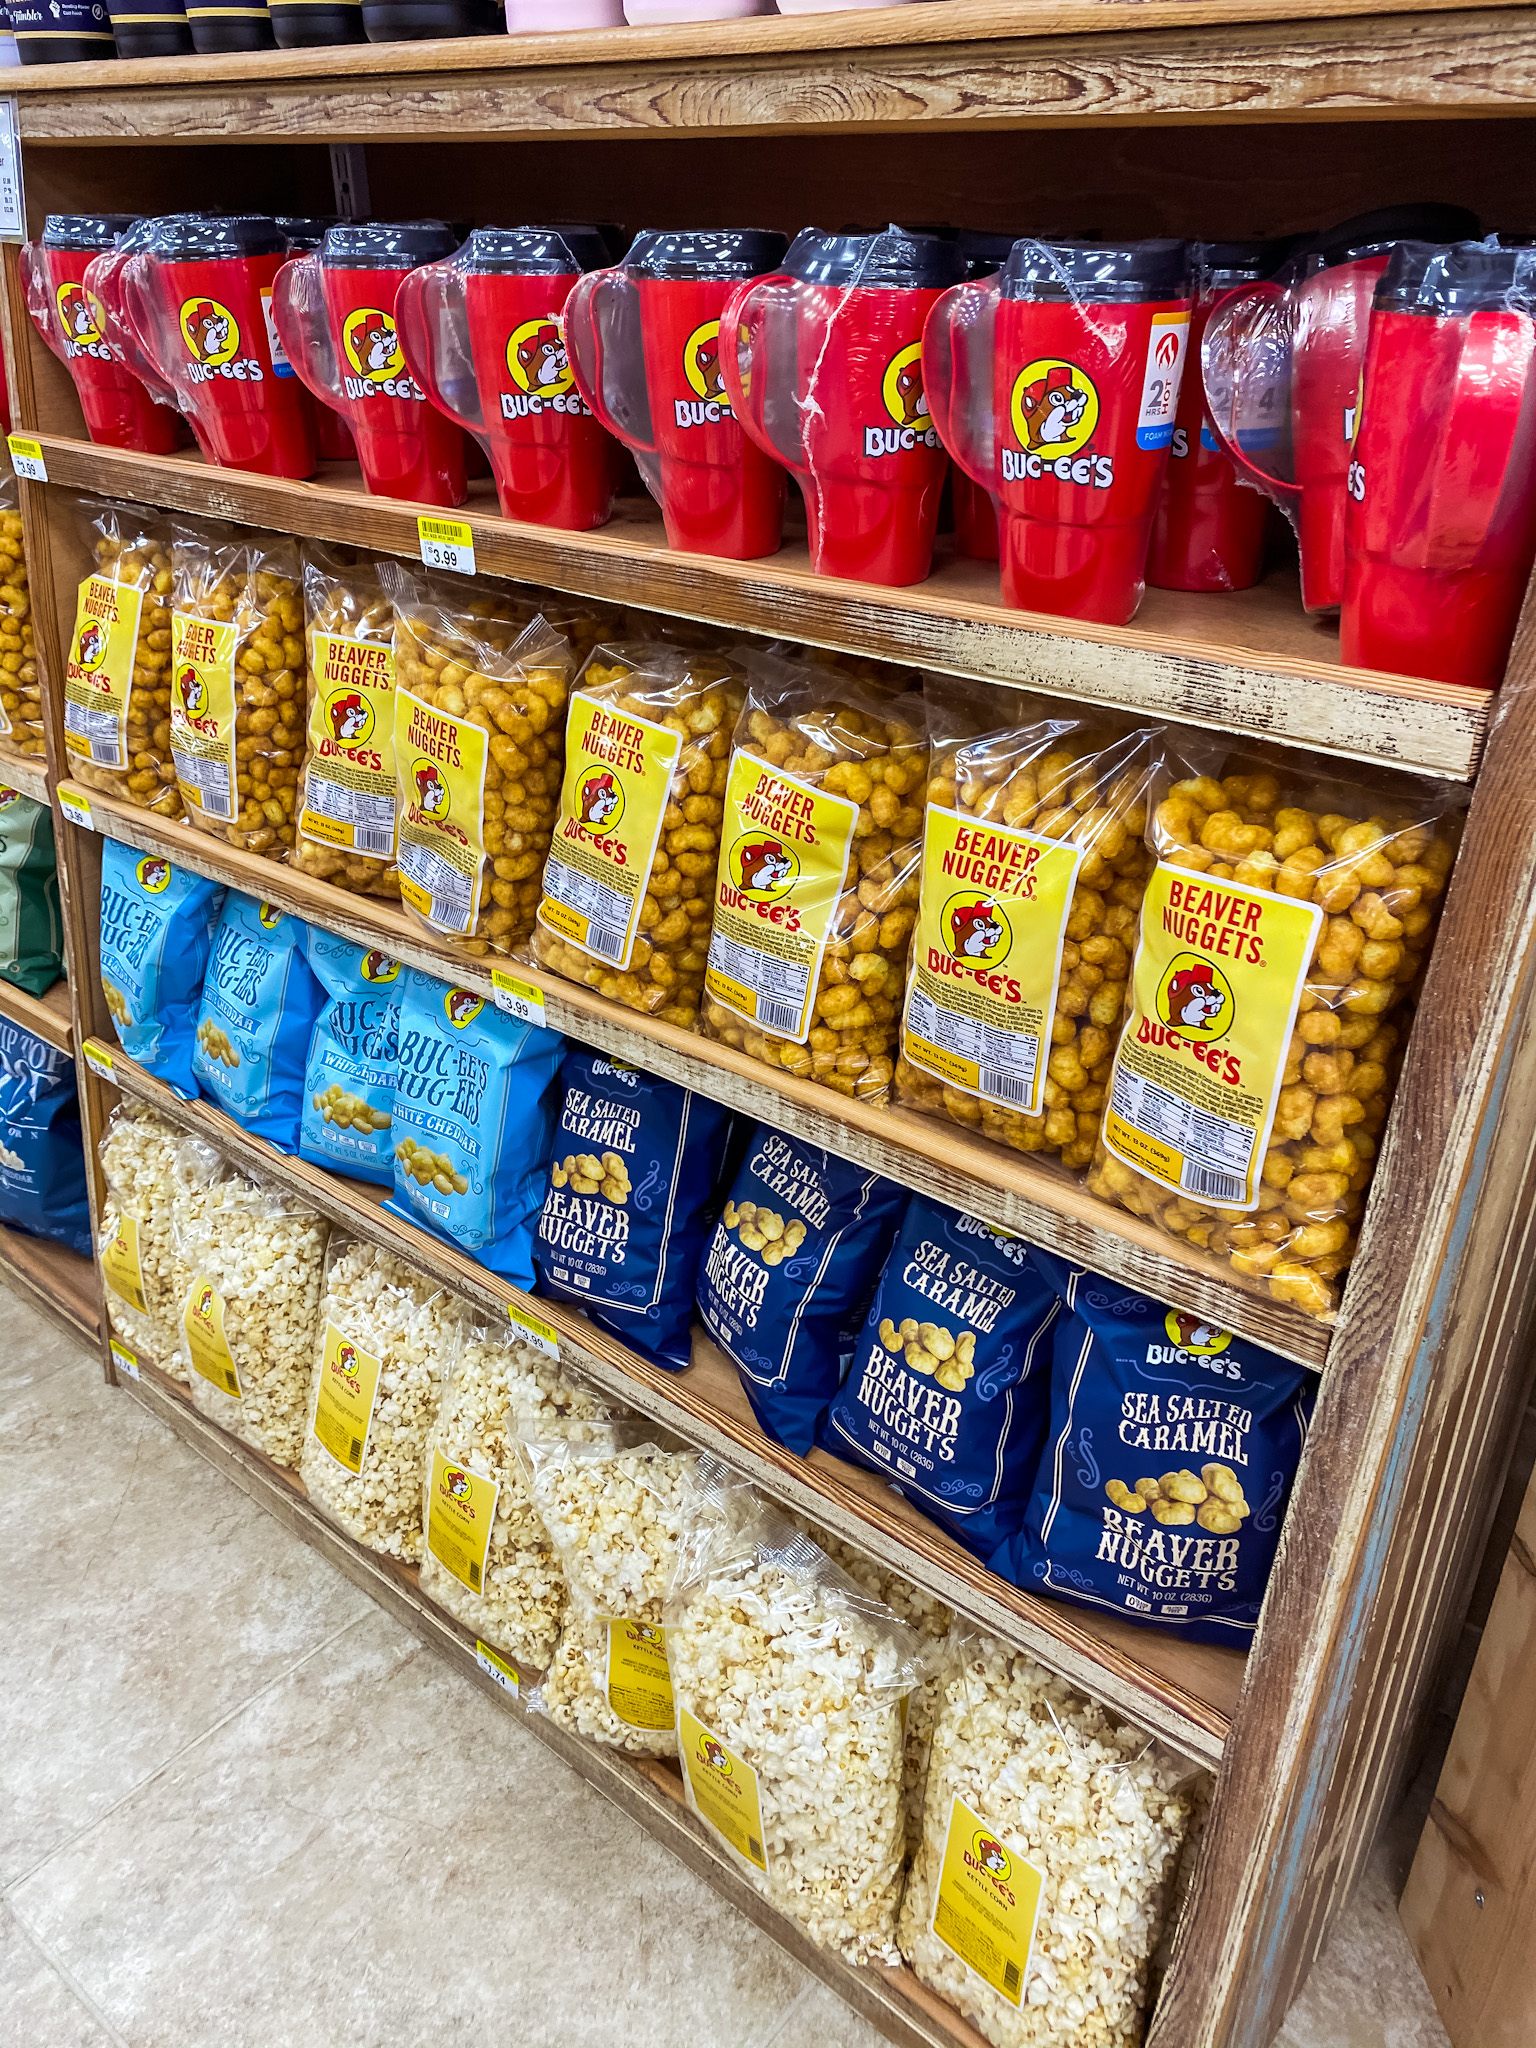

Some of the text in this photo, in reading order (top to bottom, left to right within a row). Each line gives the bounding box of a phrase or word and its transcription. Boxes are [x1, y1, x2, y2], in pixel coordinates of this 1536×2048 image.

[187, 358, 264, 383] BUC-EE'S
[1145, 407, 1162, 416] HRS
[1148, 379, 1164, 408] 2
[1162, 378, 1172, 415] HOT
[1001, 448, 1114, 488] BUC-EE'S
[428, 546, 457, 567] $3.99
[83, 600, 119, 623] NUGGETS
[89, 582, 117, 604] BEAVER
[325, 662, 391, 690] NUGGETS
[330, 643, 386, 670] BEAVER
[408, 725, 461, 768] NUGGETS
[414, 707, 458, 746] BEAVER
[591, 711, 645, 751] BEAVER
[319, 738, 382, 771] BUC-EE'S
[582, 731, 644, 775] NUGGETS
[742, 793, 816, 845] NUGGETS
[755, 773, 815, 822] BEAVER
[564, 817, 628, 865] BUC-EE'S
[955, 827, 1041, 872] BEAVER
[942, 850, 1038, 899] NUGGETS
[720, 882, 801, 932] BUC-EE'S
[1169, 880, 1263, 932] BEAVER
[1163, 906, 1264, 965] NUGGETS
[928, 946, 1022, 1003] BUC-EE'S
[500, 994, 529, 1016] $3.99
[20, 1036, 70, 1073] TOP
[398, 1030, 490, 1092] BUC-EE'S
[1136, 1015, 1241, 1086] BUC-EE'S
[592, 1059, 638, 1087] BUC-EE'S
[565, 1088, 641, 1128] SEA SALTED
[1124, 1113, 1135, 1124] 140
[562, 1110, 636, 1153] CARAMEL
[763, 1134, 793, 1172] SEA
[1150, 1147, 1170, 1163] (369g)
[749, 1153, 831, 1231] CARAMEL
[543, 1188, 630, 1241] BEAVER
[539, 1214, 627, 1264] NUGGETS
[955, 1213, 1027, 1266] BUC-EE'S
[568, 1256, 575, 1267] 10
[575, 1259, 584, 1270] OZ
[585, 1262, 607, 1276] (283G)
[712, 1222, 770, 1306] BEAVER
[914, 1240, 1016, 1309] SEA SALTED
[704, 1249, 762, 1329] NUGGETS
[903, 1261, 1002, 1334] CARAMEL
[331, 1360, 360, 1394] BUC-EE'S
[1146, 1343, 1242, 1381] BUC-EE'S
[864, 1344, 963, 1437] BEAVER
[857, 1374, 958, 1462] NUGGETS
[1121, 1391, 1252, 1434] SEA SALTED
[868, 1418, 880, 1435] NET
[891, 1436, 899, 1449] 10
[910, 1449, 935, 1472] (283G)
[1118, 1418, 1249, 1467] CARAMEL
[440, 1483, 475, 1519] BUC-EE'S
[1102, 1506, 1241, 1572] BEAVER
[1095, 1530, 1236, 1592] NUGGETS
[1117, 1573, 1136, 1588] NET
[1152, 1591, 1163, 1601] 10
[1180, 1592, 1213, 1603] (283G)
[633, 1644, 653, 1656] KETTLE
[963, 1850, 1016, 1907] BUC-EE'S
[966, 1870, 1009, 1911] KETTLE CORN
